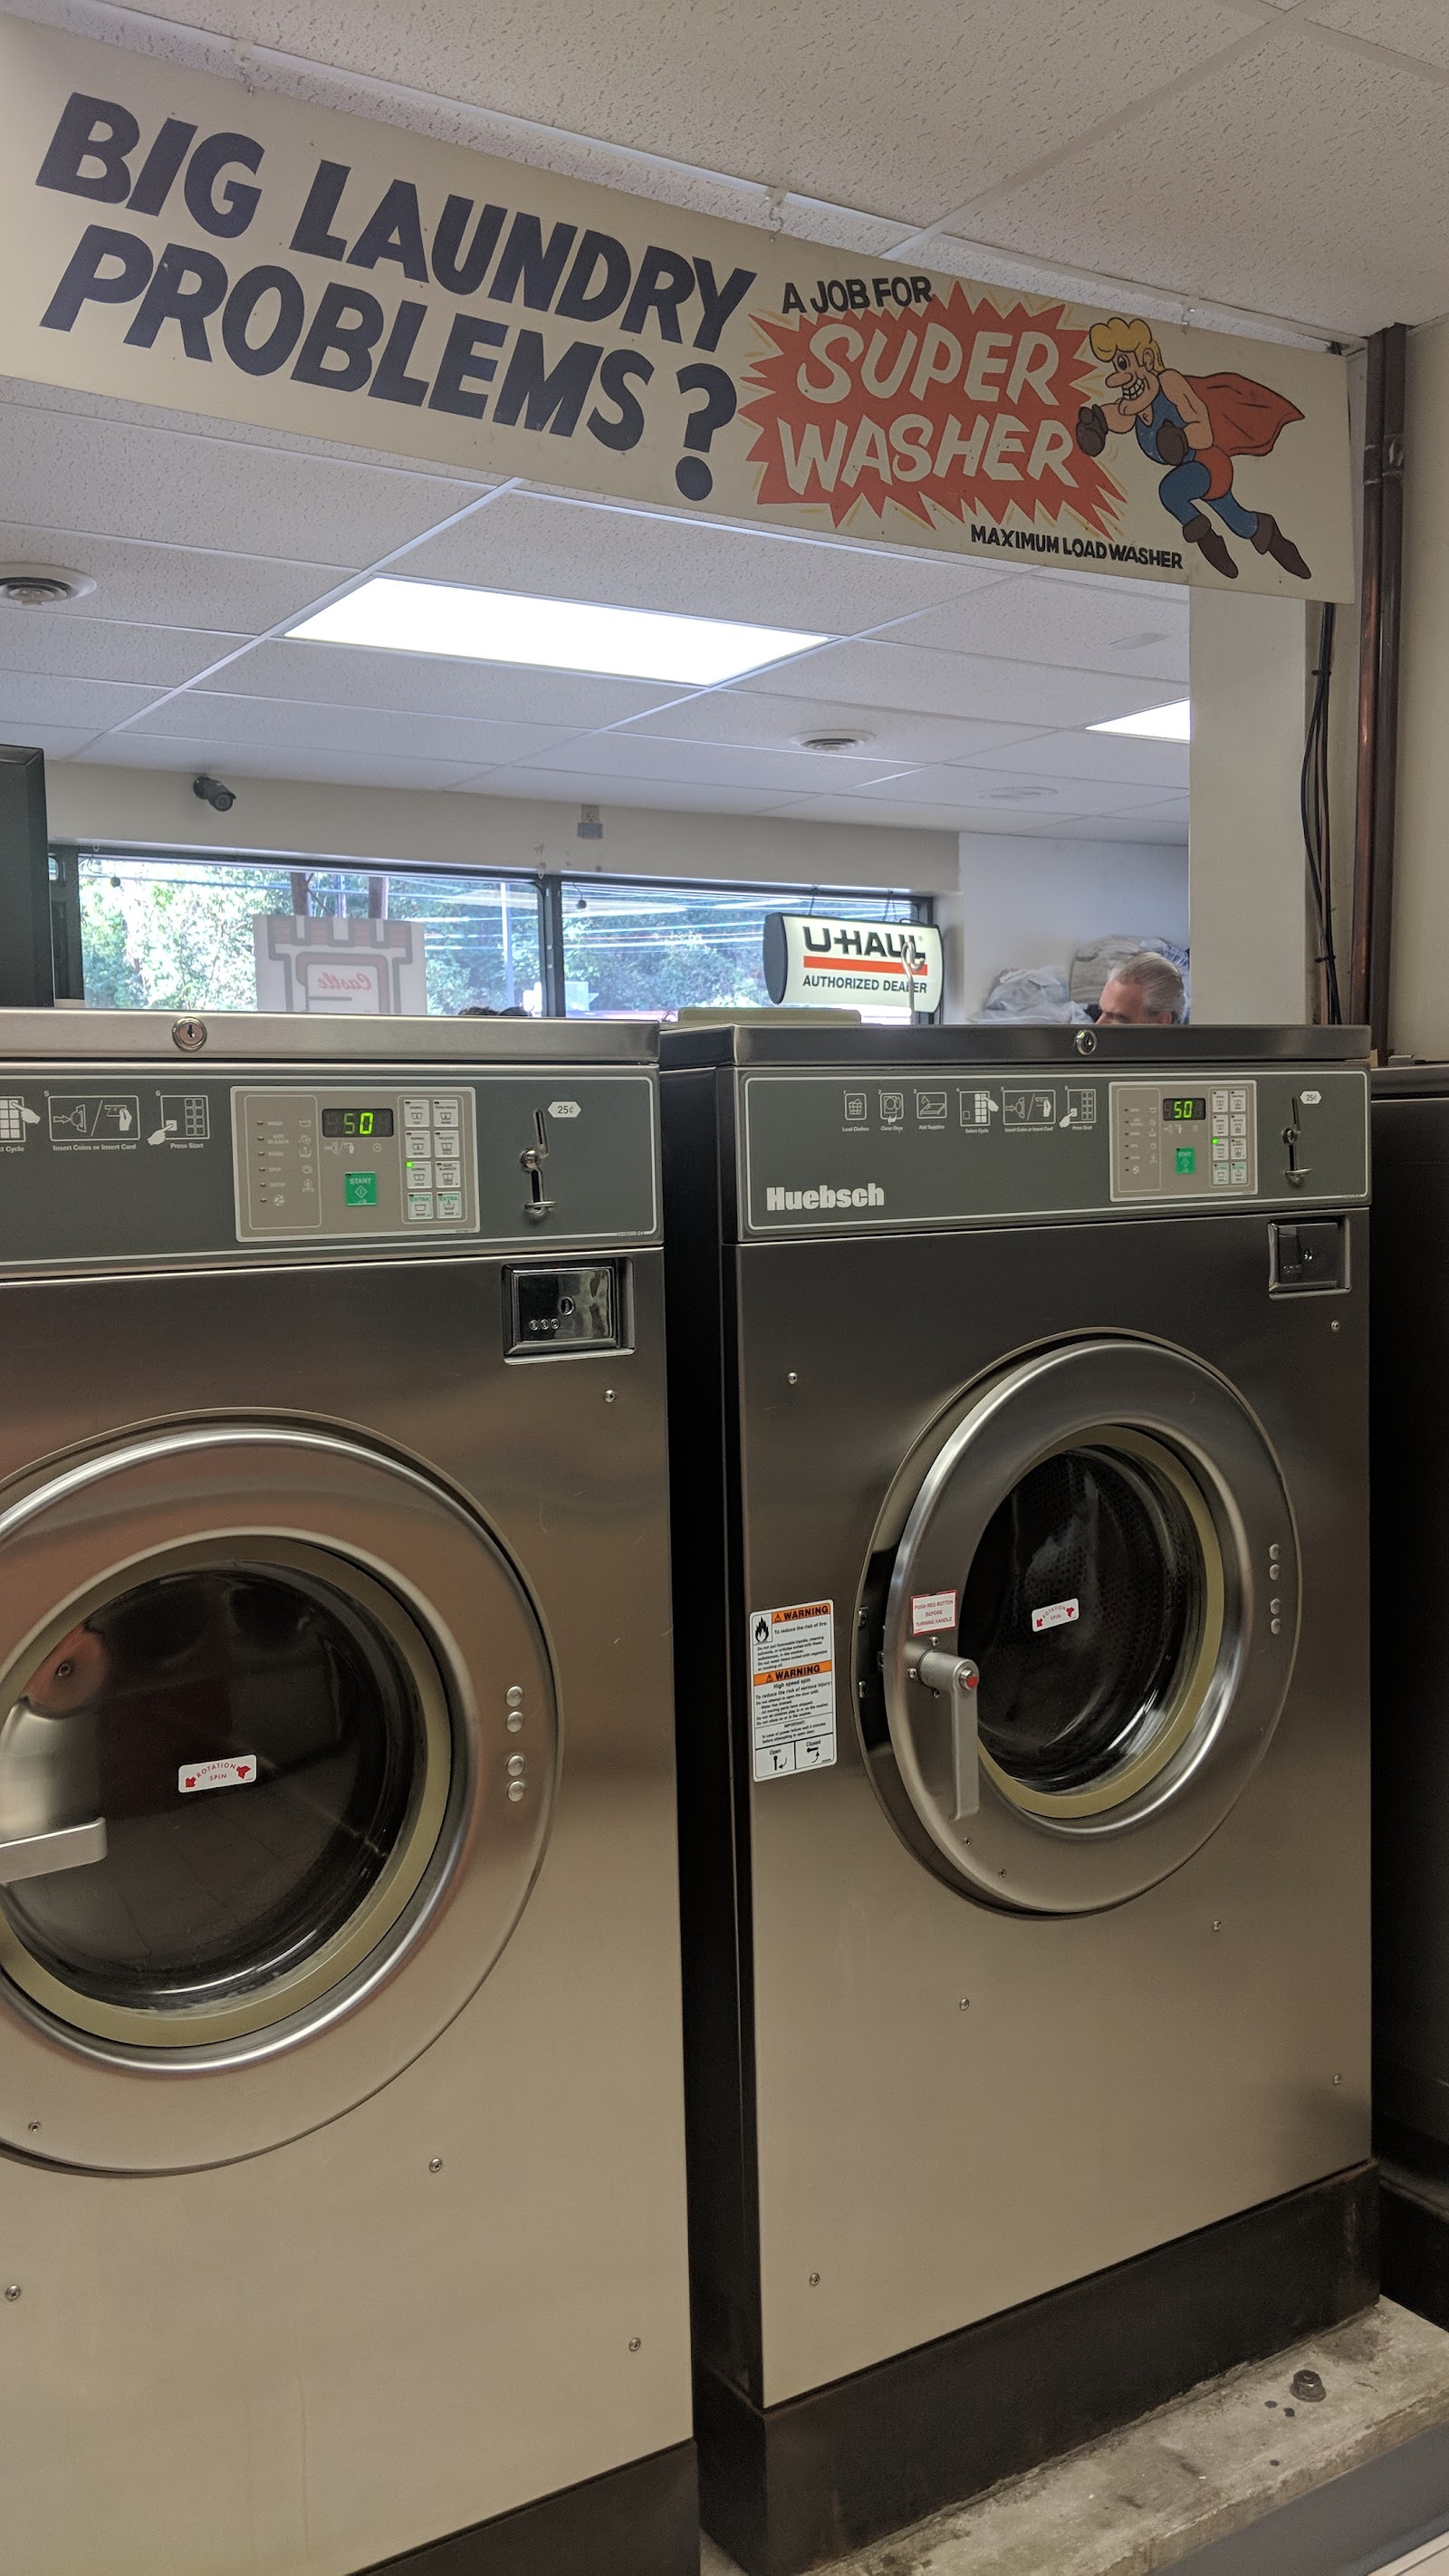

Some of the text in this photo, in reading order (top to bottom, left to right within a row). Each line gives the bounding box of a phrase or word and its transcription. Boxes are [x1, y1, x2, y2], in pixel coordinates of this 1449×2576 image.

[36, 91, 757, 353] BIG LAUNDRY
[782, 276, 932, 313] A JOB FOR
[796, 322, 1060, 406] SUPER
[777, 412, 1080, 495] WASHER
[971, 524, 1184, 570] MAXIMUM LOAD WASHER
[802, 975, 879, 991] AUTHORIZED
[1174, 1101, 1193, 1119] 50
[343, 1111, 373, 1135] 50
[766, 1182, 885, 1212] Huebsch
[784, 1605, 828, 1620] WARNING
[925, 1610, 943, 1618] BEFORE
[916, 1616, 953, 1628] TURNING HANDLE
[775, 1665, 820, 1680] WARNING
[196, 1762, 236, 1778] ROTATION
[209, 1773, 227, 1782] SPIN
